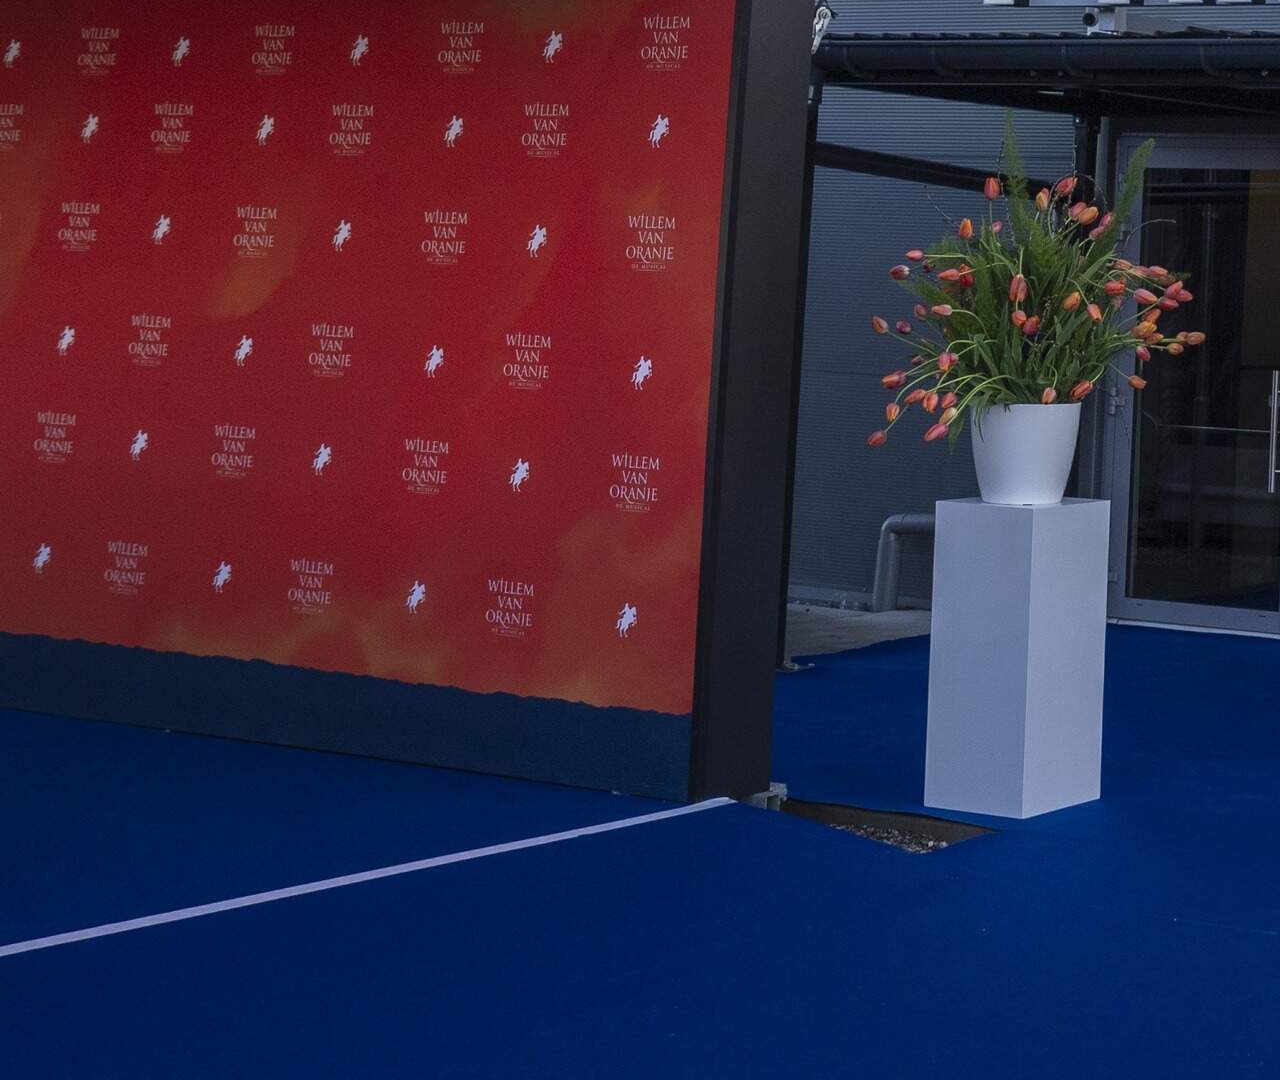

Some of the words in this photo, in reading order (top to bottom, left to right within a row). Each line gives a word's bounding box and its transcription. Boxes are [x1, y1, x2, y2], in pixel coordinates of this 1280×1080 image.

[440, 20, 484, 34] WILLEM
[644, 14, 690, 30] WILLEM
[81, 27, 120, 40] WILLEM
[255, 23, 295, 37] WILLEM
[263, 39, 284, 51] VAN
[450, 36, 472, 48] VAN
[654, 32, 678, 44] VAN
[89, 40, 109, 52] VAN
[78, 53, 116, 68] ORANJE
[252, 52, 292, 68] ORANJE
[438, 49, 482, 66] ORANJE
[641, 46, 688, 63] ORANJE
[155, 102, 193, 115] WILLEM
[332, 102, 374, 117] WILLEM
[524, 102, 569, 116] WILLEM
[162, 117, 184, 128] VAN
[340, 119, 363, 131] VAN
[534, 119, 558, 131] VAN
[151, 130, 191, 146] ORANJE
[329, 132, 371, 149] ORANJE
[522, 132, 566, 150] ORANJE
[62, 200, 100, 215] WILLEM
[237, 205, 276, 219] WILLEM
[69, 216, 90, 228] VAN
[424, 210, 468, 224] WILLEM
[628, 212, 675, 229] WILLEM
[245, 221, 266, 233] VAN
[433, 226, 456, 238] VAN
[58, 228, 96, 243] ORANJE
[233, 234, 274, 250] ORANJE
[638, 232, 664, 244] VAN
[421, 240, 465, 256] ORANJE
[626, 246, 674, 263] ORANJE
[132, 314, 171, 329] WILLEM
[139, 329, 160, 341] VAN
[312, 324, 354, 338] WILLEM
[320, 339, 343, 352] VAN
[506, 332, 550, 348] WILLEM
[128, 342, 168, 358] ORANJE
[515, 350, 540, 362] VAN
[308, 352, 352, 370] ORANJE
[504, 364, 549, 381] ORANJE
[37, 411, 76, 426] WILLEM
[44, 426, 66, 438] VAN
[214, 424, 256, 439] WILLEM
[34, 439, 72, 454] ORANJE
[222, 440, 245, 452] VAN
[405, 437, 448, 454] WILLEM
[212, 452, 252, 469] ORANJE
[414, 455, 438, 467] VAN
[612, 452, 660, 470] WILLEM
[402, 468, 446, 484] ORANJE
[622, 470, 648, 484] VAN
[610, 485, 658, 503] ORANJE
[108, 540, 148, 557] WILLEM
[115, 557, 137, 570] VAN
[291, 559, 333, 576] WILLEM
[104, 570, 145, 585] ORANJE
[299, 575, 322, 588] VAN
[488, 578, 534, 596] WILLEM
[288, 588, 331, 606] ORANJE
[498, 596, 522, 610] VAN
[486, 610, 532, 628] ORANJE
